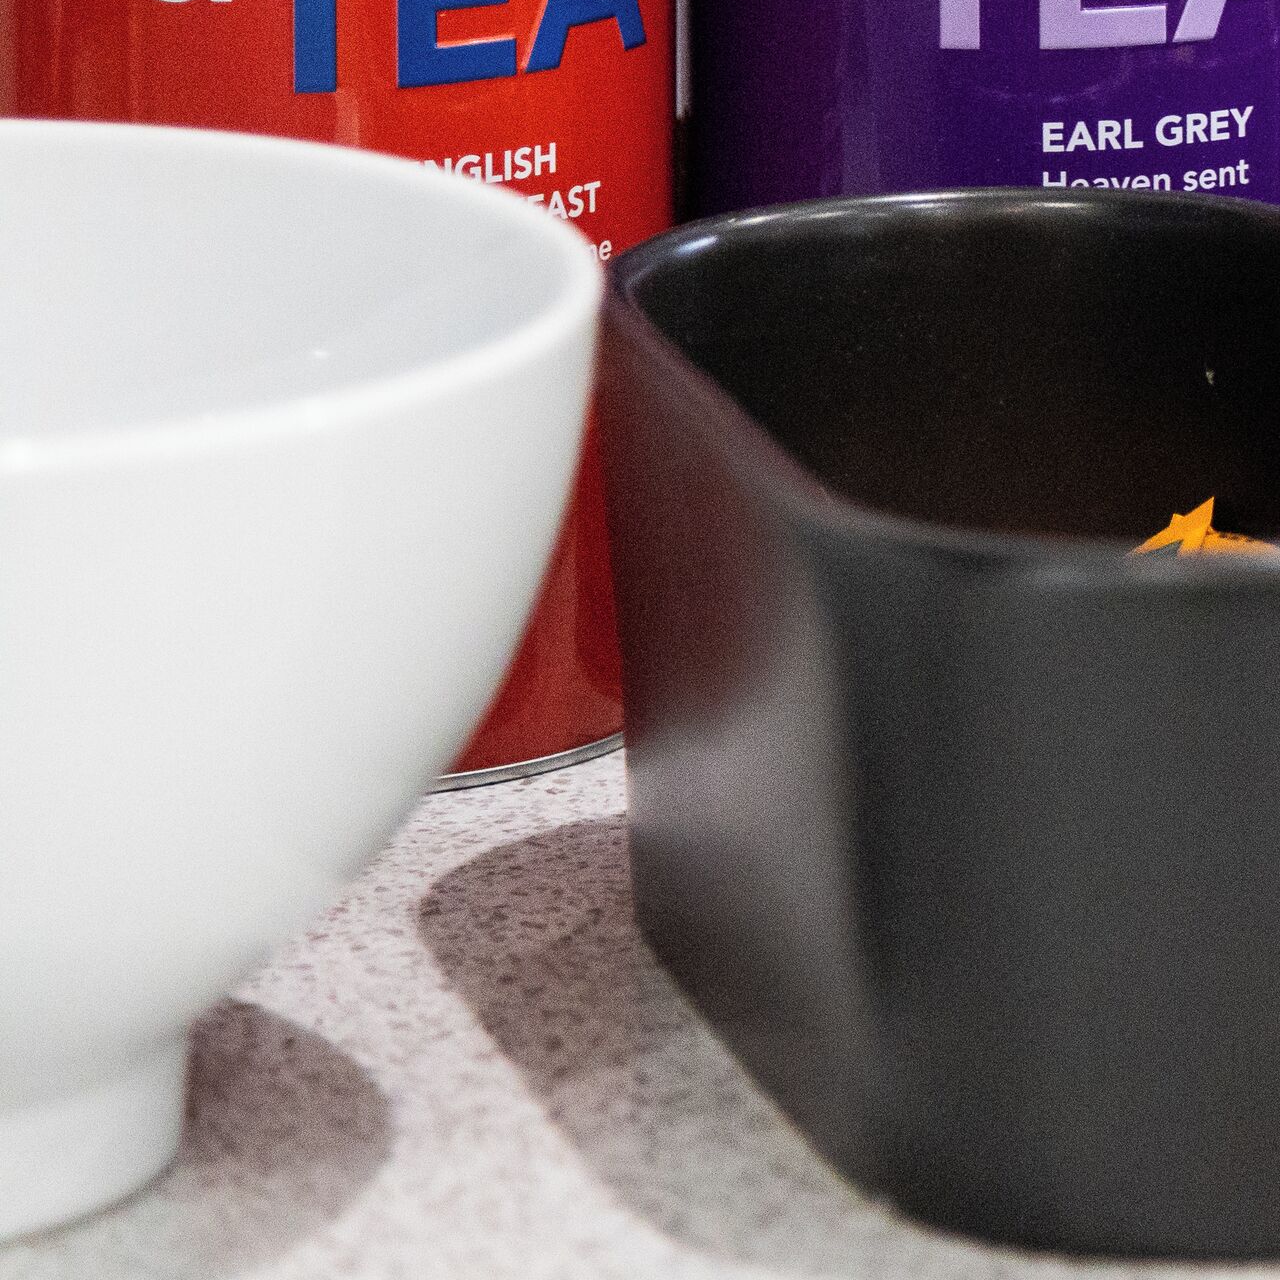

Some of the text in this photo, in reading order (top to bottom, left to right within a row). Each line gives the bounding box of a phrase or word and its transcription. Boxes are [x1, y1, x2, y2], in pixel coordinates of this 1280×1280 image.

[1042, 106, 1253, 152] EARL GREY
[1183, 160, 1249, 192] sent
